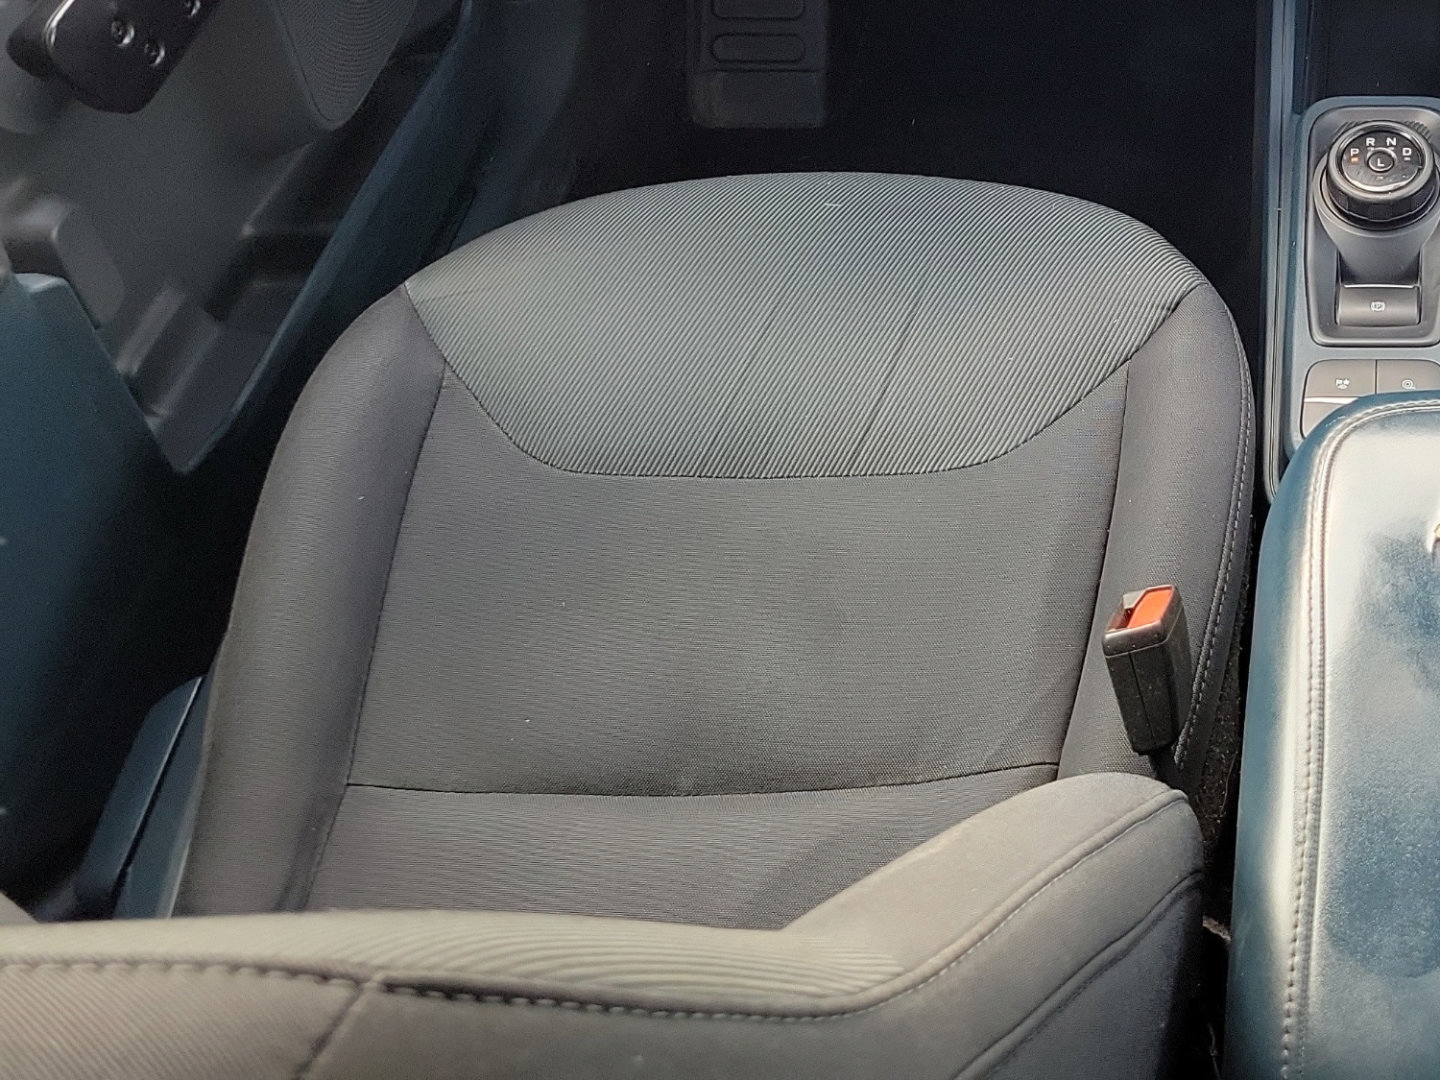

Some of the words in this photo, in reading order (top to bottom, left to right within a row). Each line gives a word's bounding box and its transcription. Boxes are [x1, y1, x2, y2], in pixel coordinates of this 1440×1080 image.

[1365, 137, 1376, 147] R
[1386, 137, 1397, 147] N
[1350, 148, 1360, 157] P
[1402, 147, 1412, 157] D
[1377, 158, 1386, 167] L
